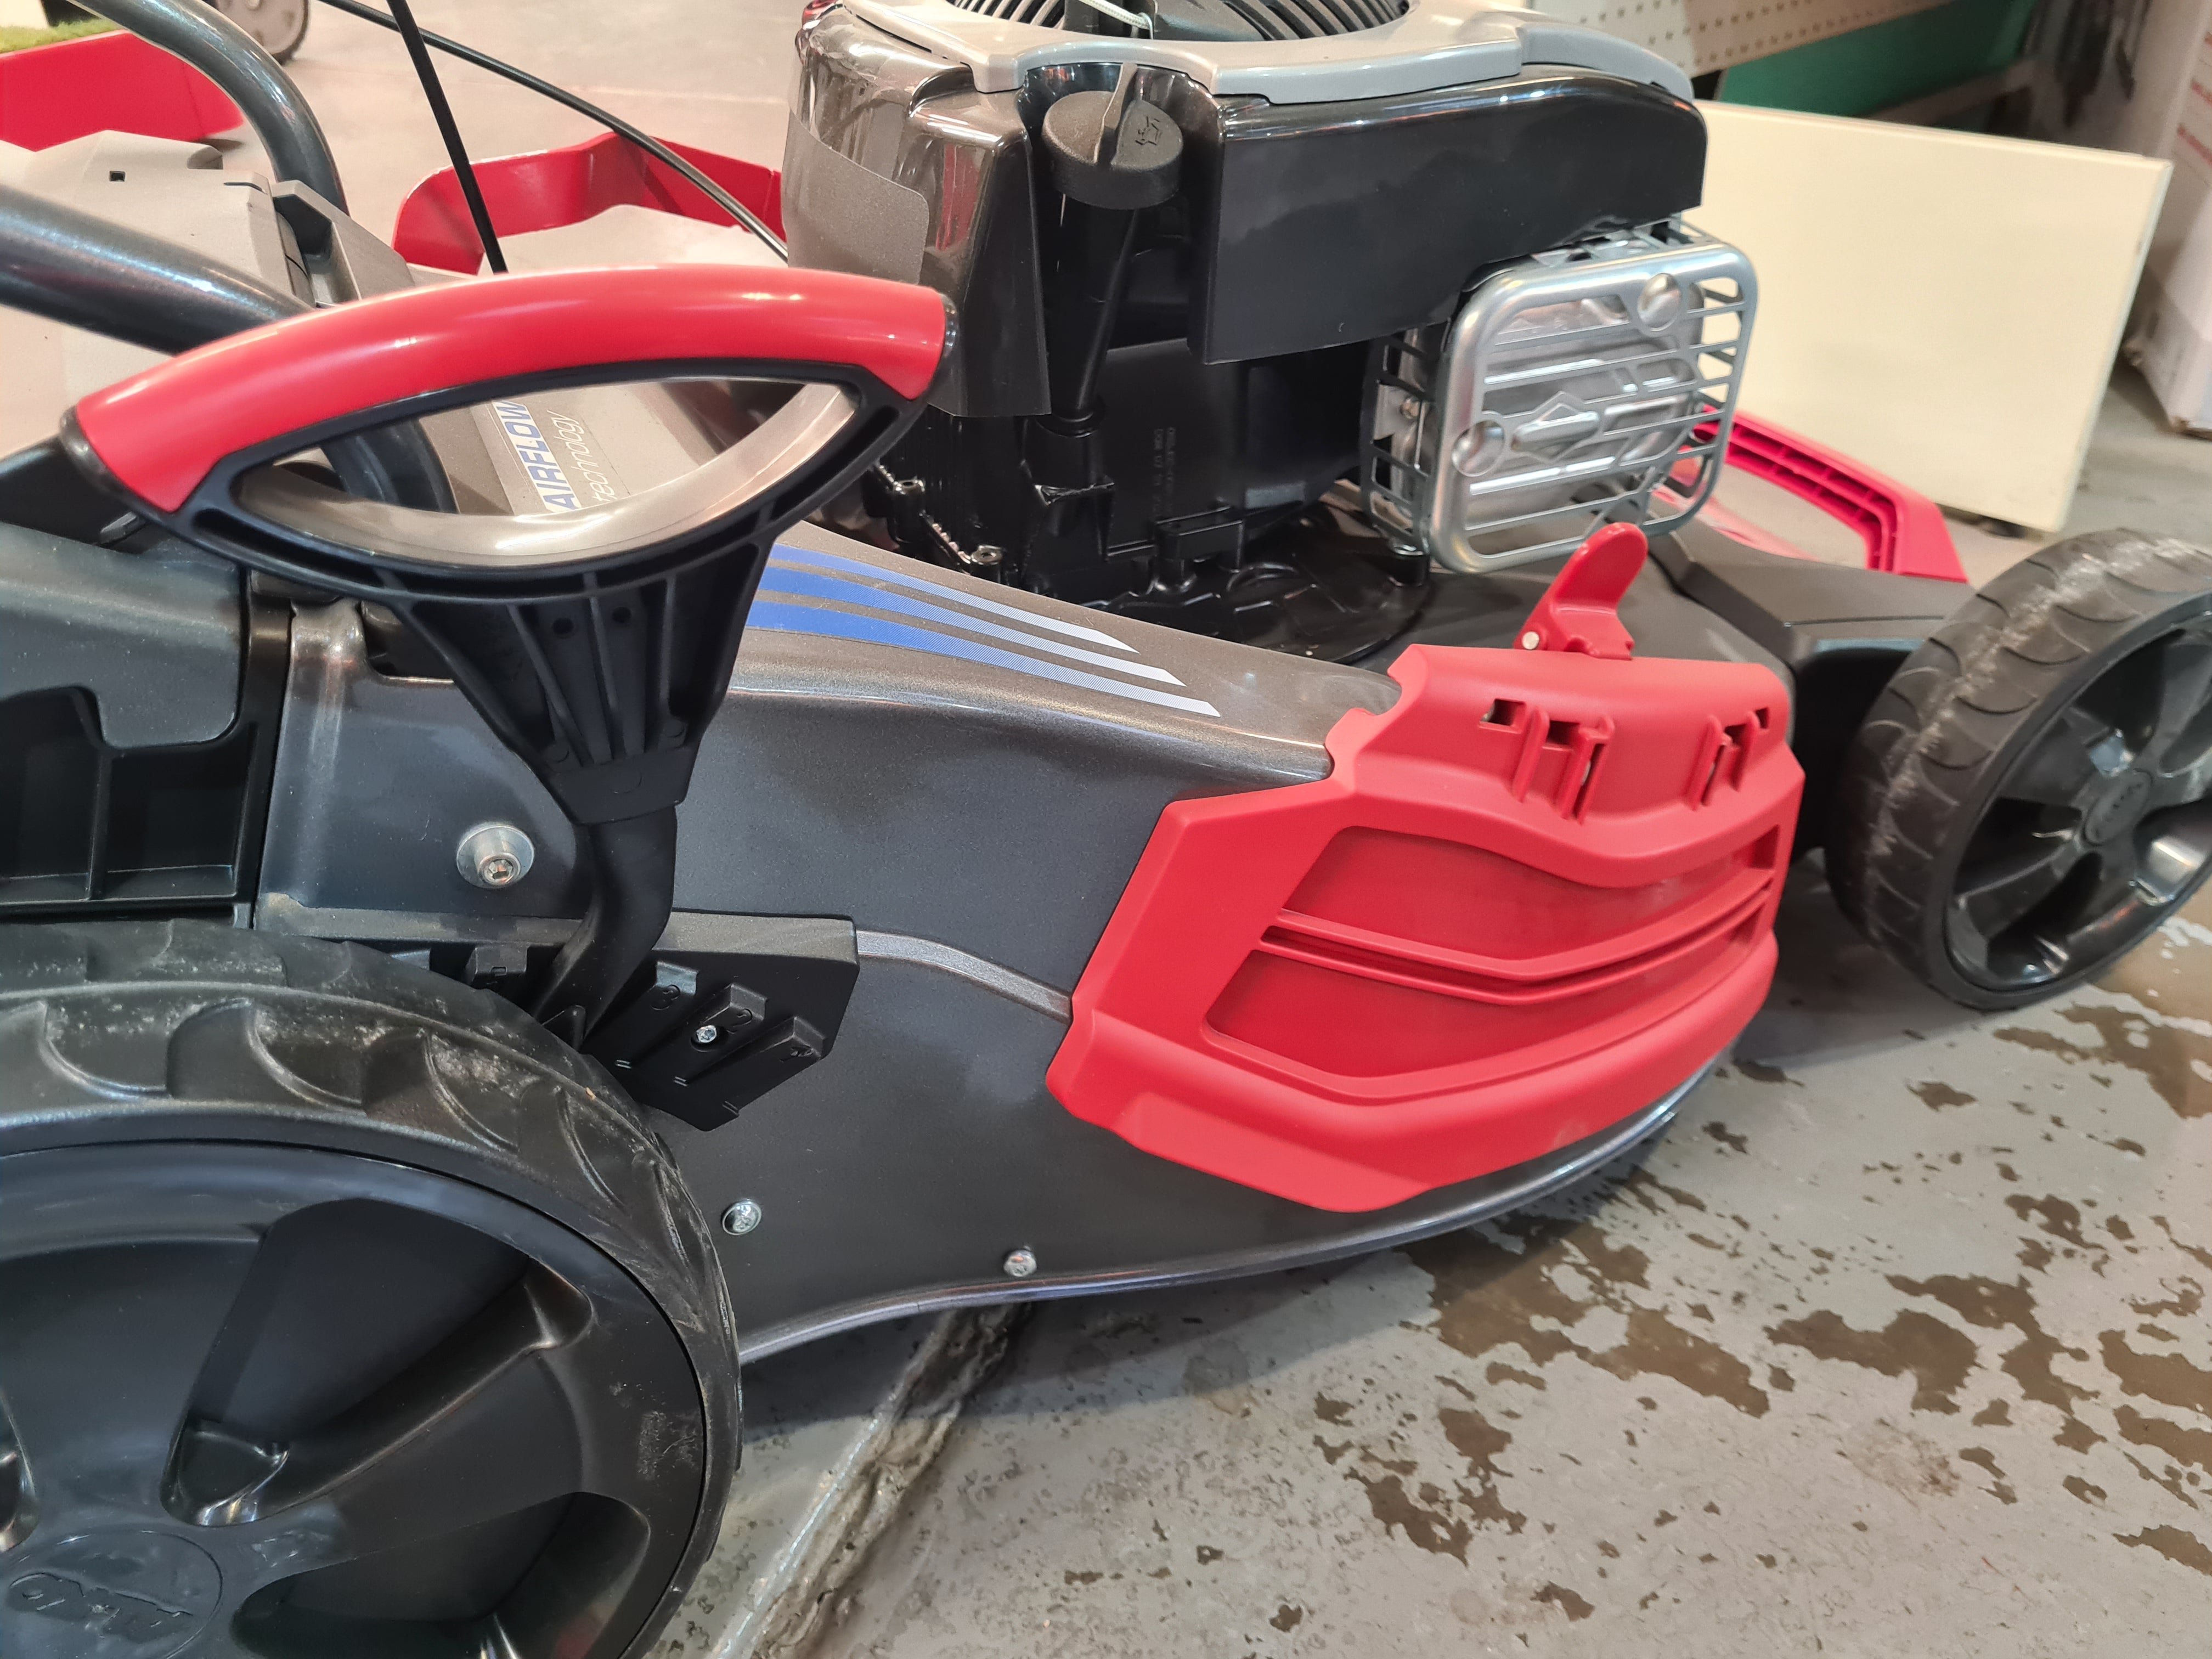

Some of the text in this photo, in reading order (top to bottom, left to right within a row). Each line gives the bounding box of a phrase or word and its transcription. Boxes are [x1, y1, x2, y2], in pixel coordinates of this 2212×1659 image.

[496, 400, 577, 510] AIRFLOW
[546, 409, 618, 502] technology
[650, 984, 681, 1011] 3
[726, 1008, 753, 1035] 2
